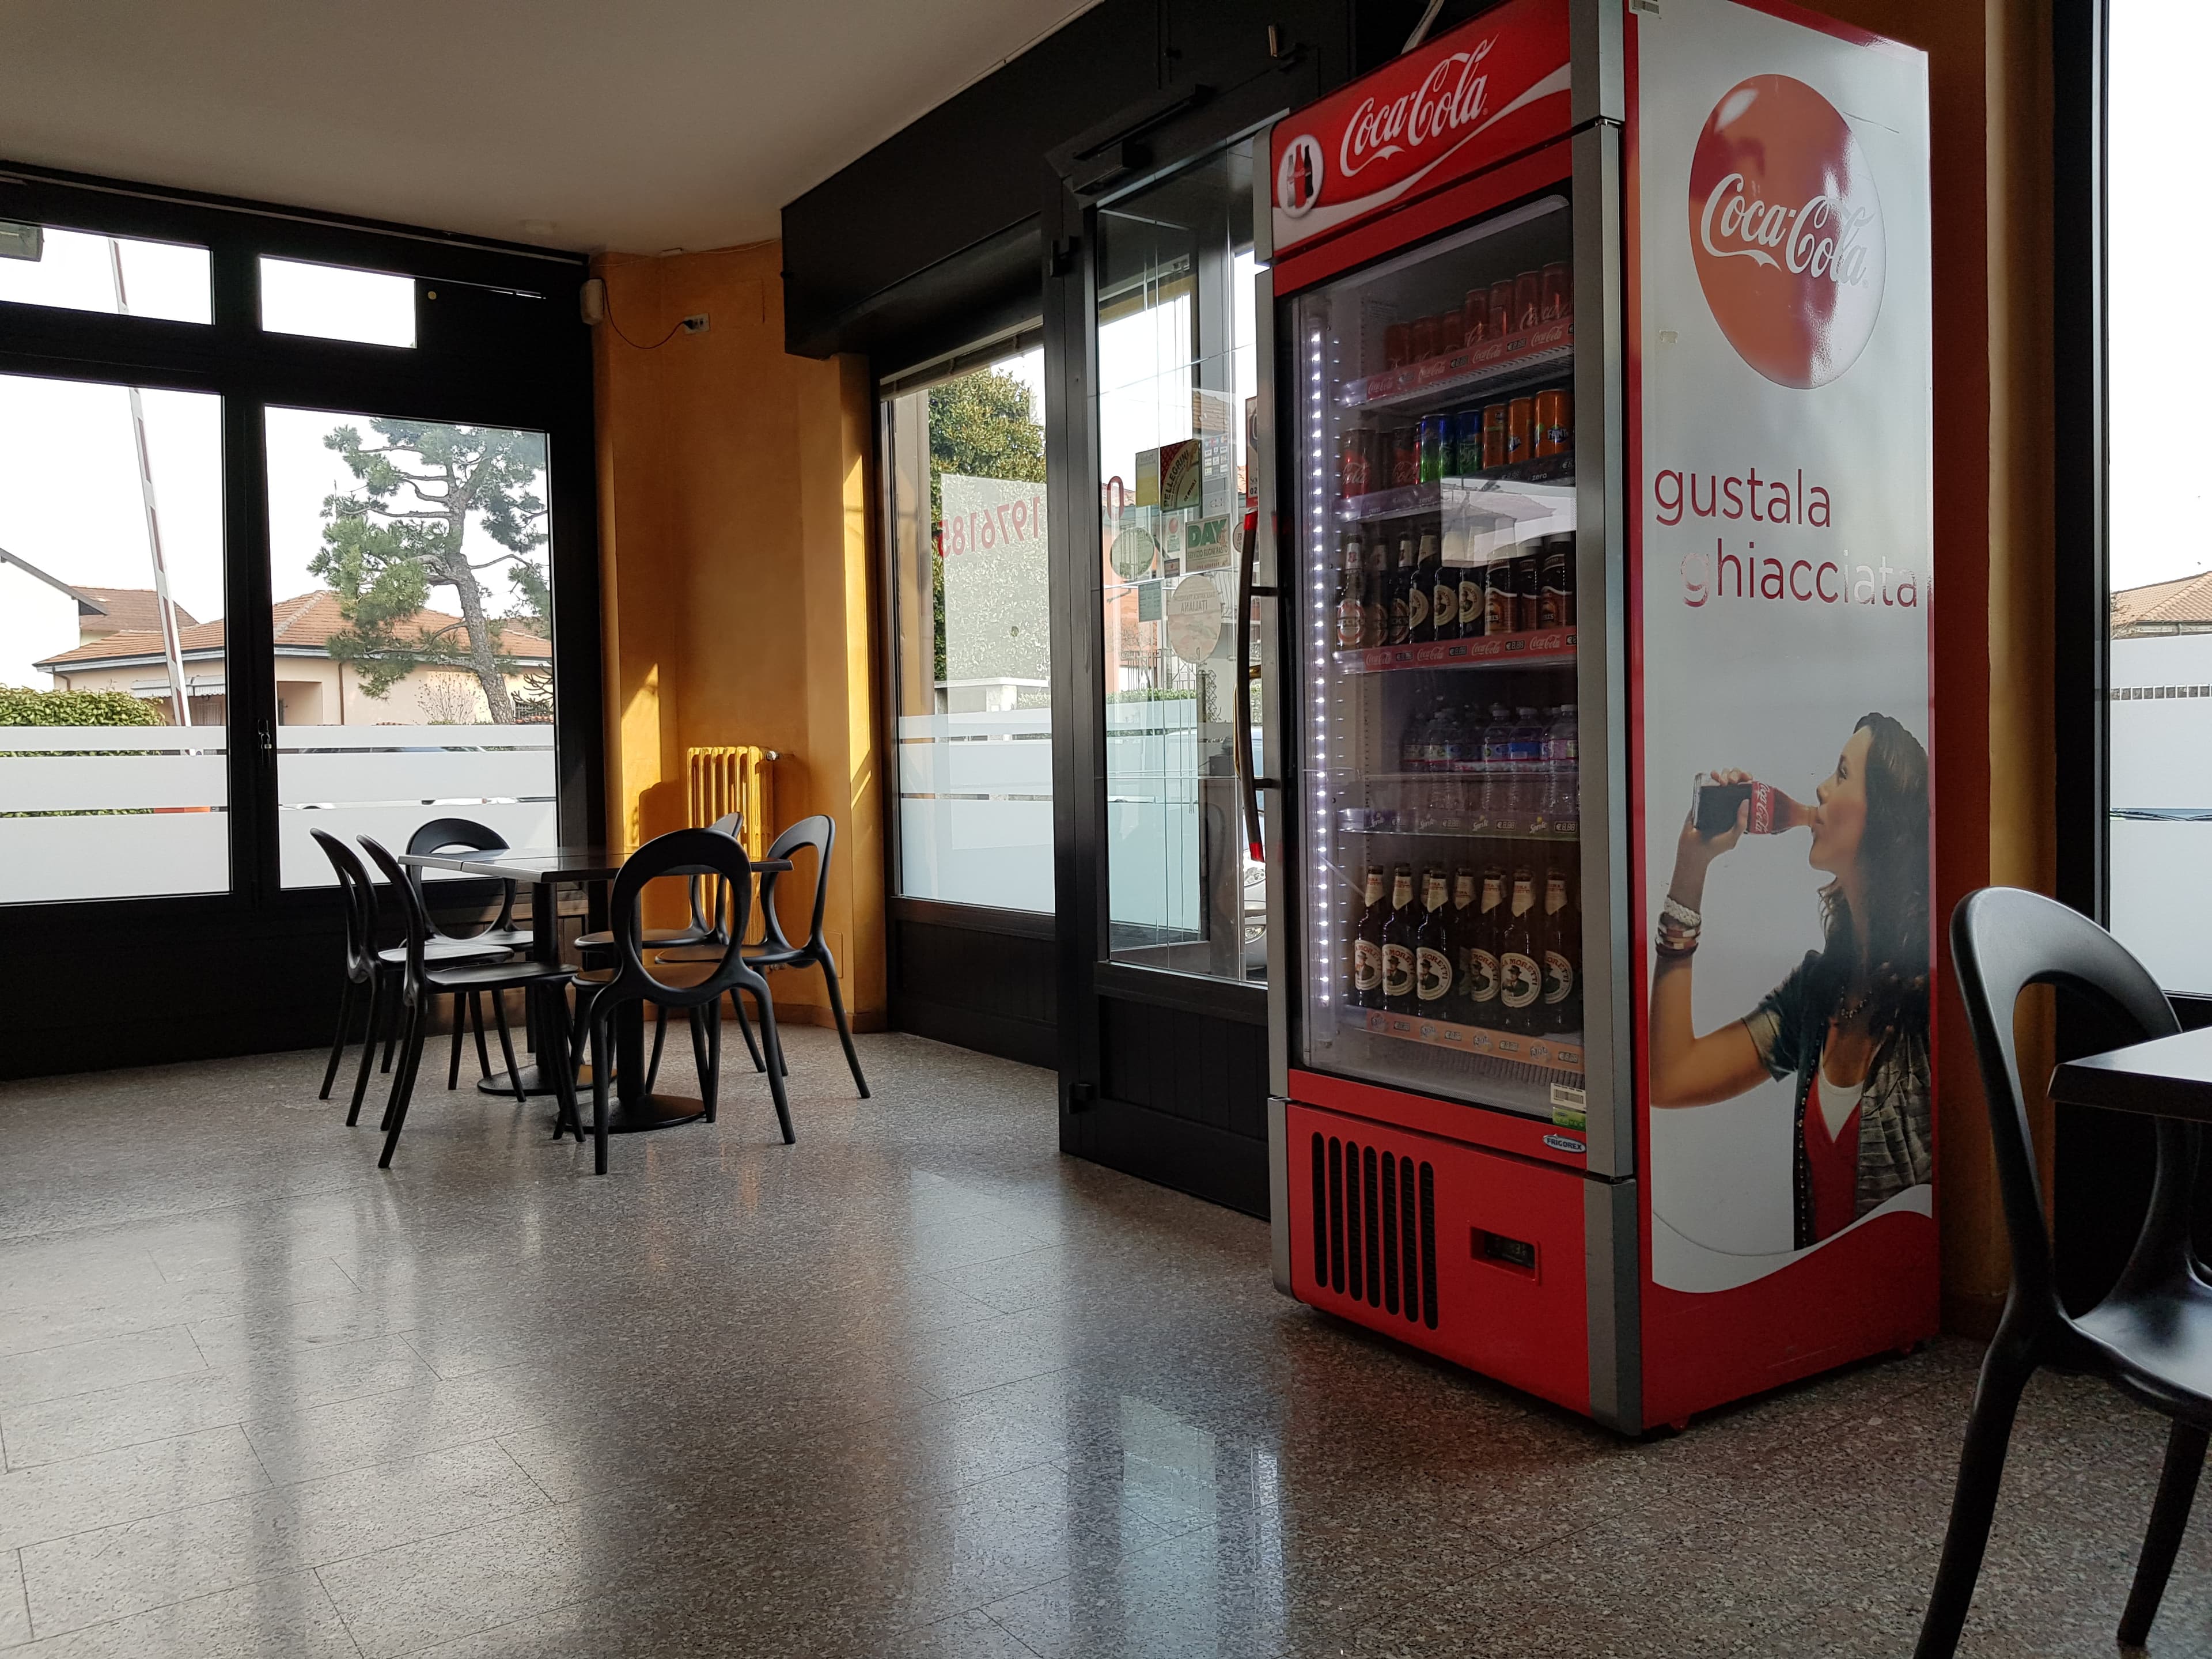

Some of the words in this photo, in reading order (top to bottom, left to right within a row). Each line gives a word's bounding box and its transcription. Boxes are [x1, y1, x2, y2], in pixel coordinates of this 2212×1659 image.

[1340, 33, 1499, 177] Coca-Cola
[1701, 173, 1874, 286] Coca-Cola
[1531, 473, 1547, 481] zero
[1654, 468, 1830, 527] gustala
[1188, 518, 1227, 548] DAY
[1680, 539, 1917, 607] ghiacciata
[1529, 822, 1547, 834] Sprite
[1389, 949, 1415, 975] MORETTI
[1422, 953, 1448, 979] MORETTI
[1510, 959, 1537, 985] MORETTI
[1547, 957, 1569, 983] ORETTI
[1547, 1138, 1582, 1151] FRIGOREX
